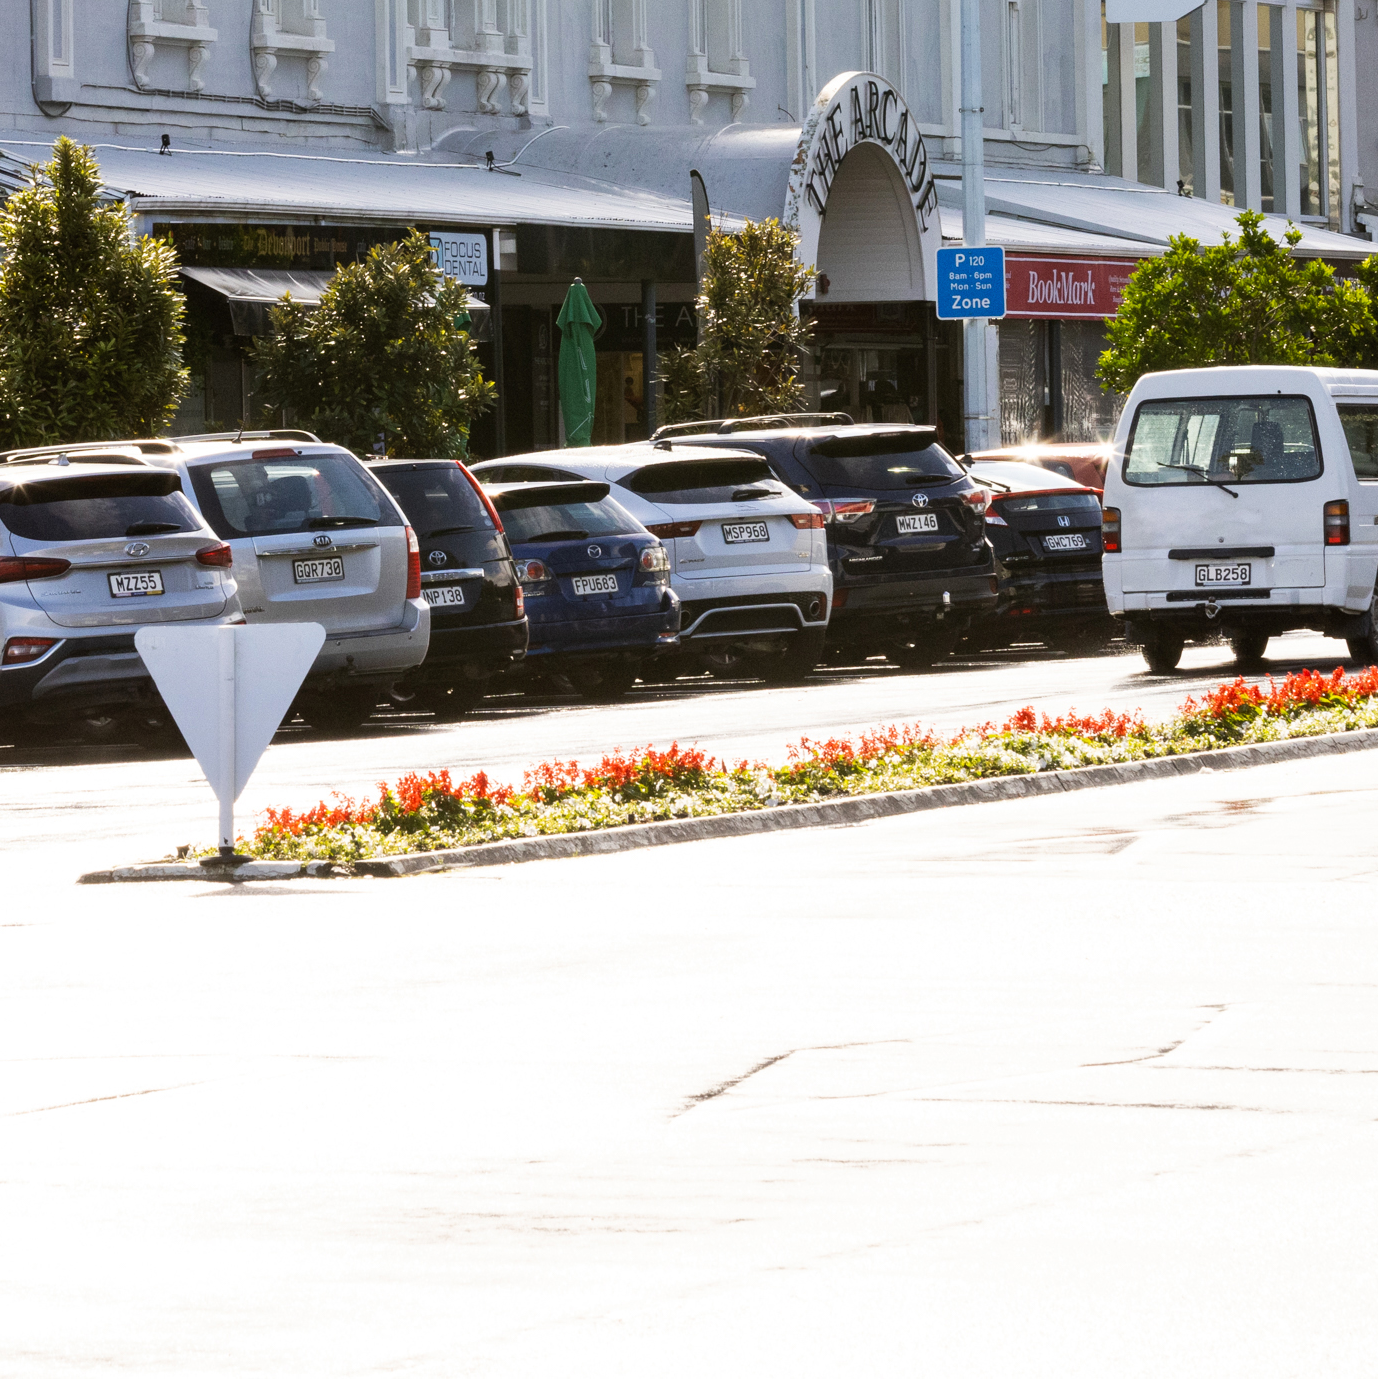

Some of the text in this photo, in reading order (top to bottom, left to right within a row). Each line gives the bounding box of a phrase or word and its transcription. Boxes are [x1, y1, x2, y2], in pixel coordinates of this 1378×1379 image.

[806, 80, 938, 233] THE ARCADE
[444, 241, 482, 259] FOCUS
[955, 253, 985, 267] P 120
[444, 259, 486, 277] DENTAL
[949, 271, 967, 280] 8am
[973, 271, 992, 281] 6pm
[950, 282, 968, 290] Mon
[975, 281, 992, 290] Sun
[1027, 269, 1095, 305] BookMark
[951, 295, 991, 309] Zone
[898, 515, 937, 531] MWZ146
[724, 525, 767, 540] MSP968
[315, 536, 331, 545] KIA
[1047, 535, 1083, 548] GWC769
[296, 560, 342, 578] GQR730
[1198, 567, 1248, 582] GLB258
[115, 575, 157, 592] MZZ55
[573, 576, 617, 593] FPU683
